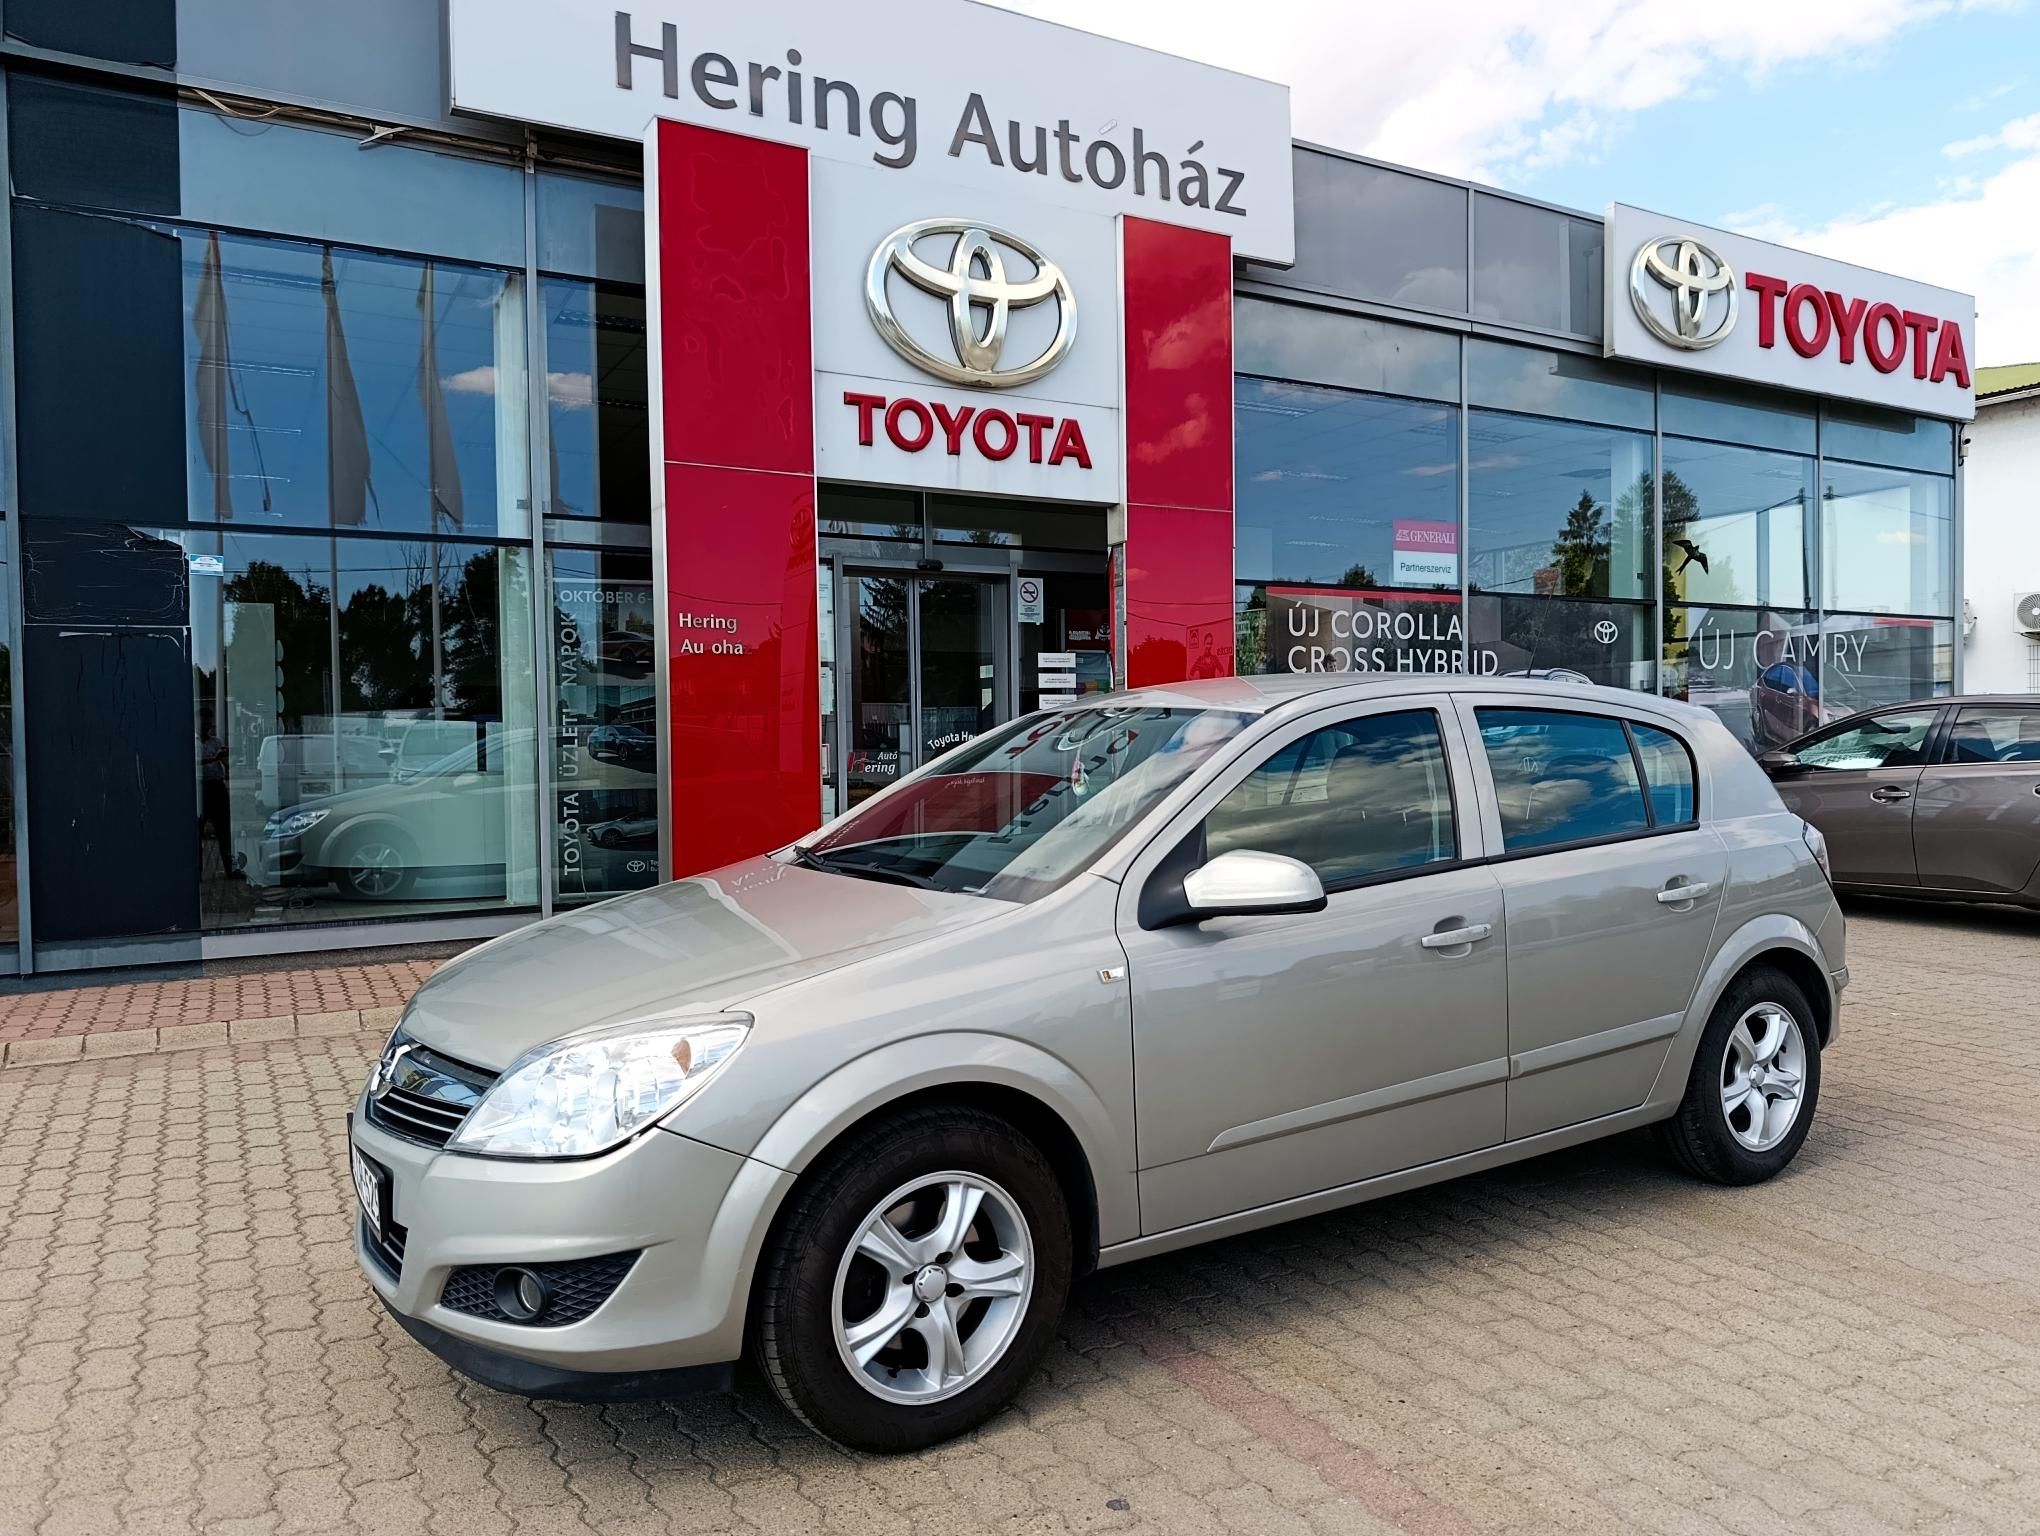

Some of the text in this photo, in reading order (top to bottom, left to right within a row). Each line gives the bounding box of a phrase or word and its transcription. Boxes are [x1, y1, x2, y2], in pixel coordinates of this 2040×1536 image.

[615, 10, 1247, 217] Hering Autóház
[1746, 271, 1971, 389] TOYOTA
[843, 391, 1093, 469] TOYOTA
[1410, 529, 1456, 545] GENERALI
[1400, 562, 1452, 574] Partnerszerviz
[560, 587, 634, 604] OKTÓBER
[679, 612, 738, 633] Hering
[1288, 600, 1463, 641] ÚJ COROLLA
[1698, 616, 1869, 672] ÚJ CAMRY
[1288, 645, 1499, 676] CROSS HYBRID
[559, 612, 580, 876] TOYOTA ÜZLETI NAPOK
[927, 732, 960, 750] Toyota
[848, 751, 896, 775] Hering
[877, 751, 898, 760] Autó
